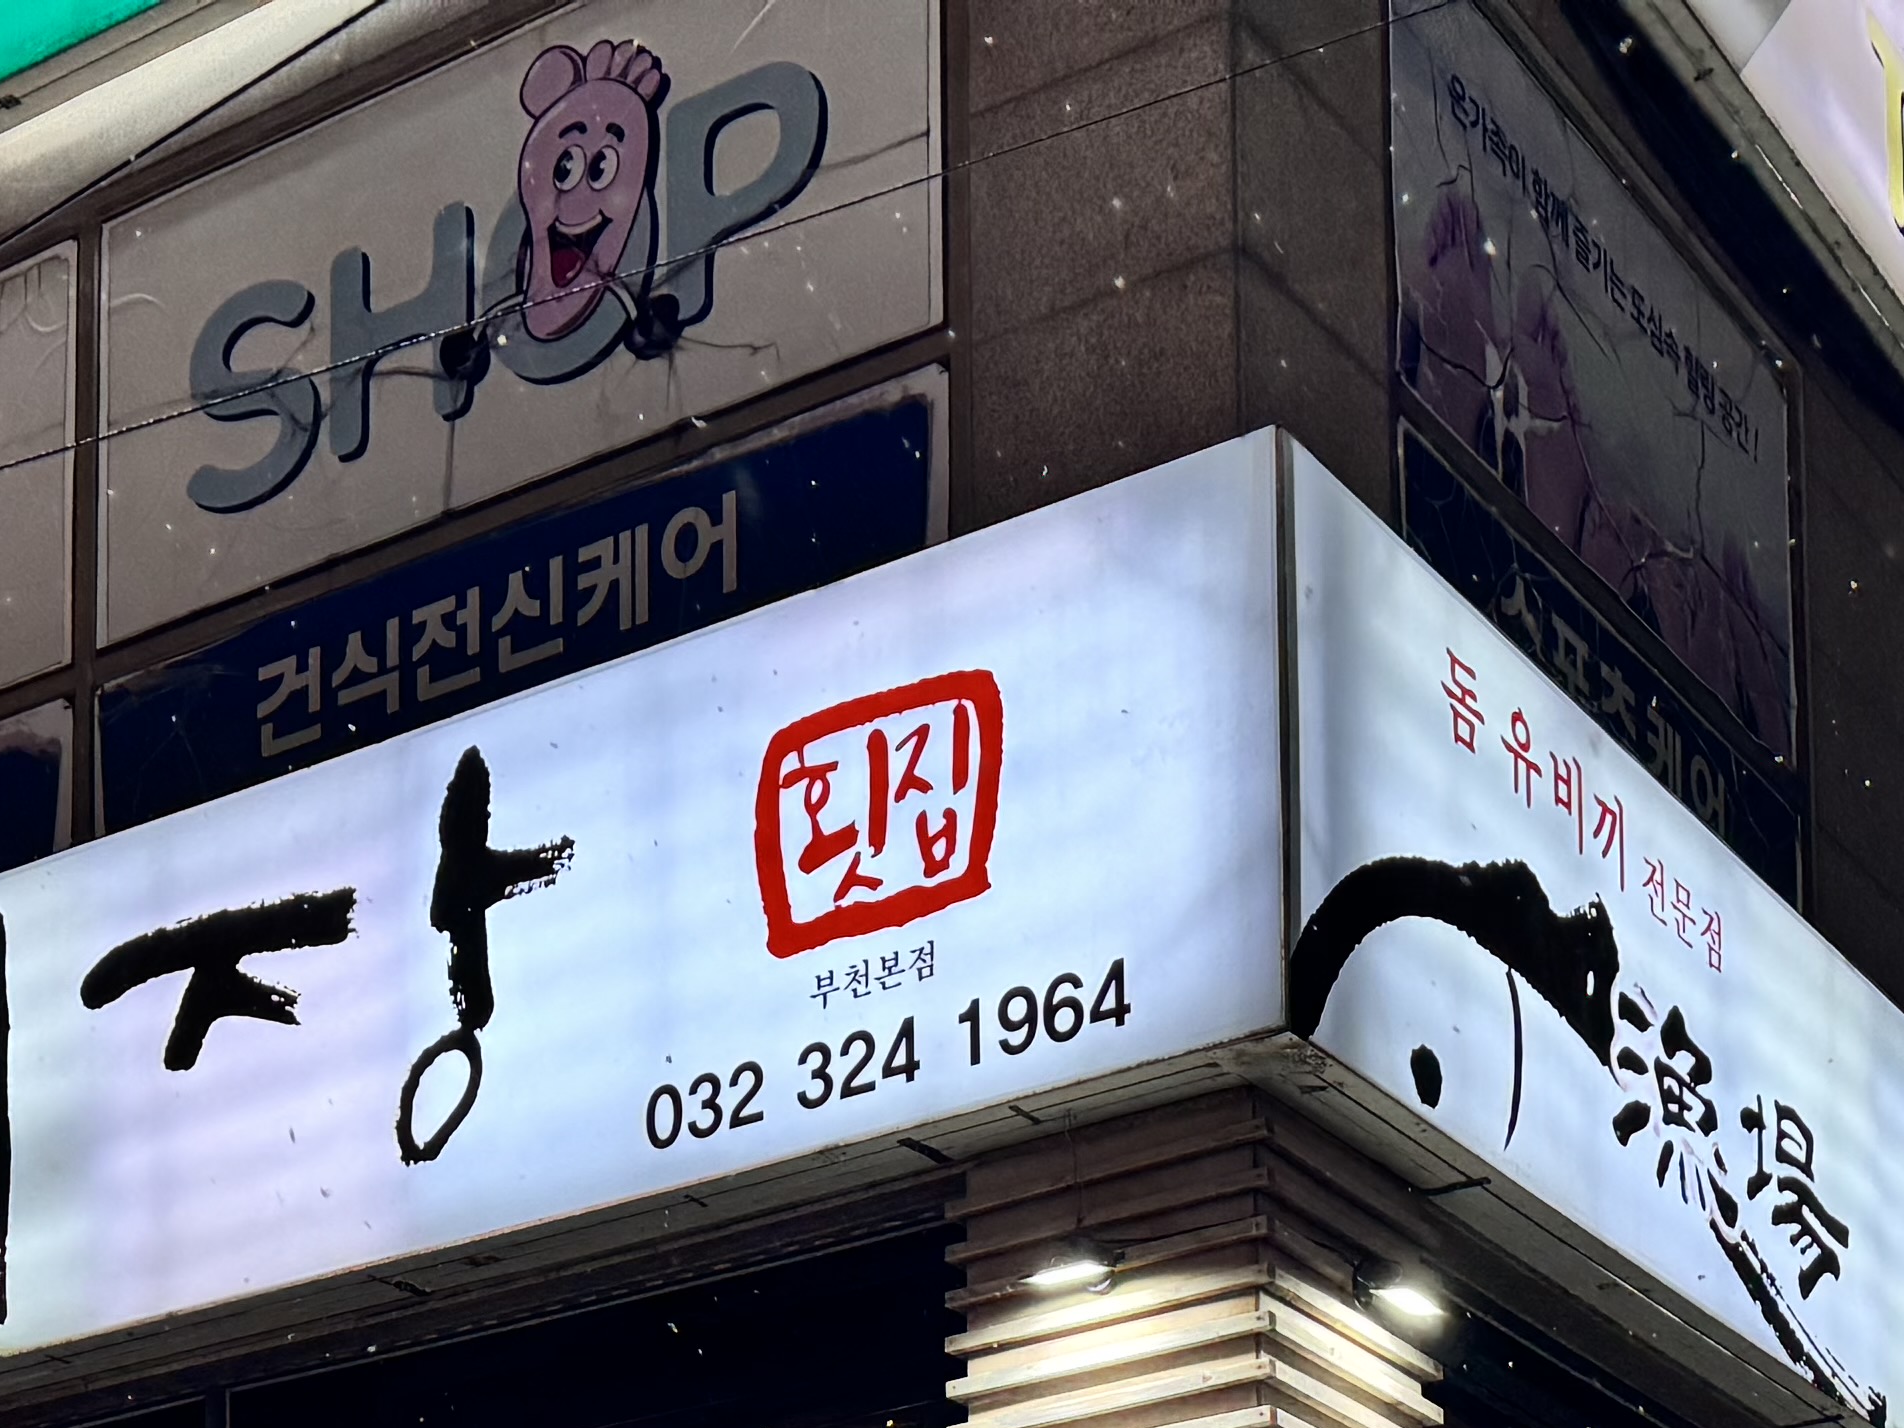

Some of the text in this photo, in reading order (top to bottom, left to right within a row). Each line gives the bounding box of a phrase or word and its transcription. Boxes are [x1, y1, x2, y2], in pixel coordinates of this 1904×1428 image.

[256, 492, 739, 758] 건식전신케어
[779, 700, 972, 906] 횟집
[1441, 647, 1725, 973] 돔 유비끼 전문점
[645, 957, 1133, 1151] 032 324 1964
[808, 940, 938, 1010] 부천본점
